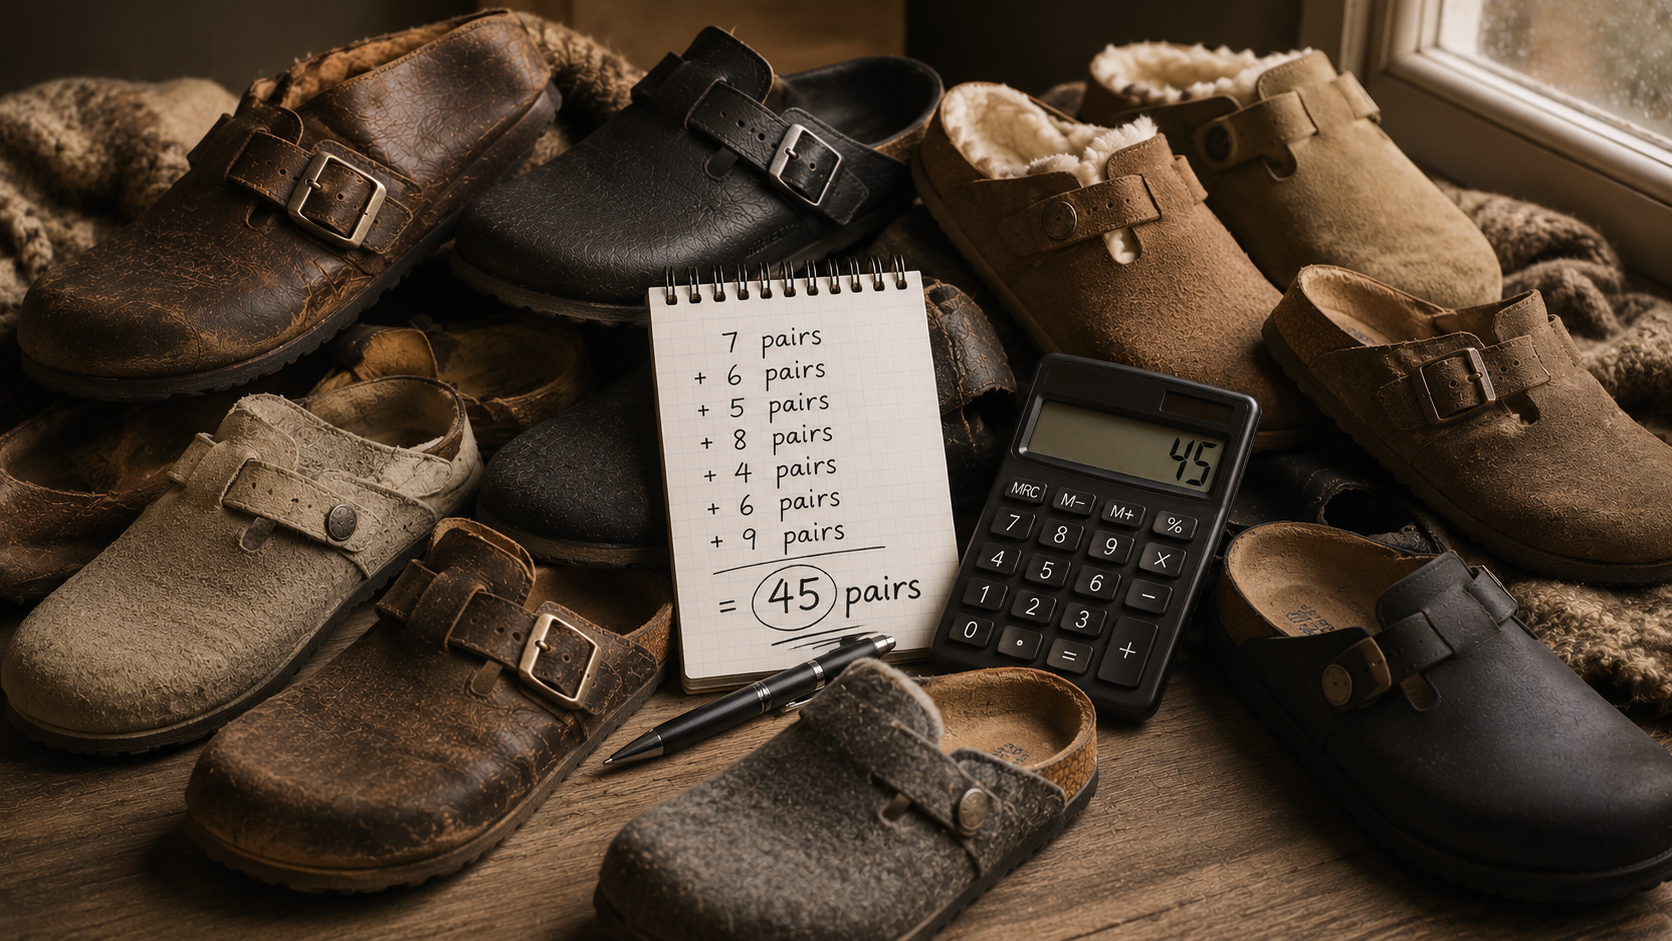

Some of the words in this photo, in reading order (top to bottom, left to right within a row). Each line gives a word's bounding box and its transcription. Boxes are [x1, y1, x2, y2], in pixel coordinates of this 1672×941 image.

[721, 331, 738, 354] 7
[761, 327, 822, 359] pairs
[727, 364, 742, 386] 6
[765, 359, 826, 392] pairs
[730, 397, 745, 418] 5
[769, 392, 830, 424] pairs
[733, 428, 747, 451] 8
[772, 424, 834, 456] pairs
[1167, 435, 1219, 487] 45
[734, 461, 752, 484] 4
[776, 455, 838, 489] pairs
[1011, 481, 1040, 498] MRC
[739, 493, 754, 516] 6
[779, 488, 841, 523] pairs
[1109, 504, 1134, 520] M+
[1006, 513, 1021, 531] 7
[1167, 516, 1183, 534] %
[742, 527, 757, 551] 9
[783, 521, 846, 556] pairs
[1053, 525, 1068, 544] 8
[1103, 537, 1118, 556] 9
[990, 550, 1005, 567] 4
[1039, 560, 1055, 580] 5
[1089, 574, 1104, 592] 6
[718, 599, 737, 614] =
[767, 577, 821, 614] 45
[845, 575, 922, 619] pairs
[980, 585, 990, 603] 1
[1025, 597, 1040, 616] 2
[1075, 610, 1090, 629] 3
[963, 620, 978, 639] 0
[1061, 650, 1077, 661] =
